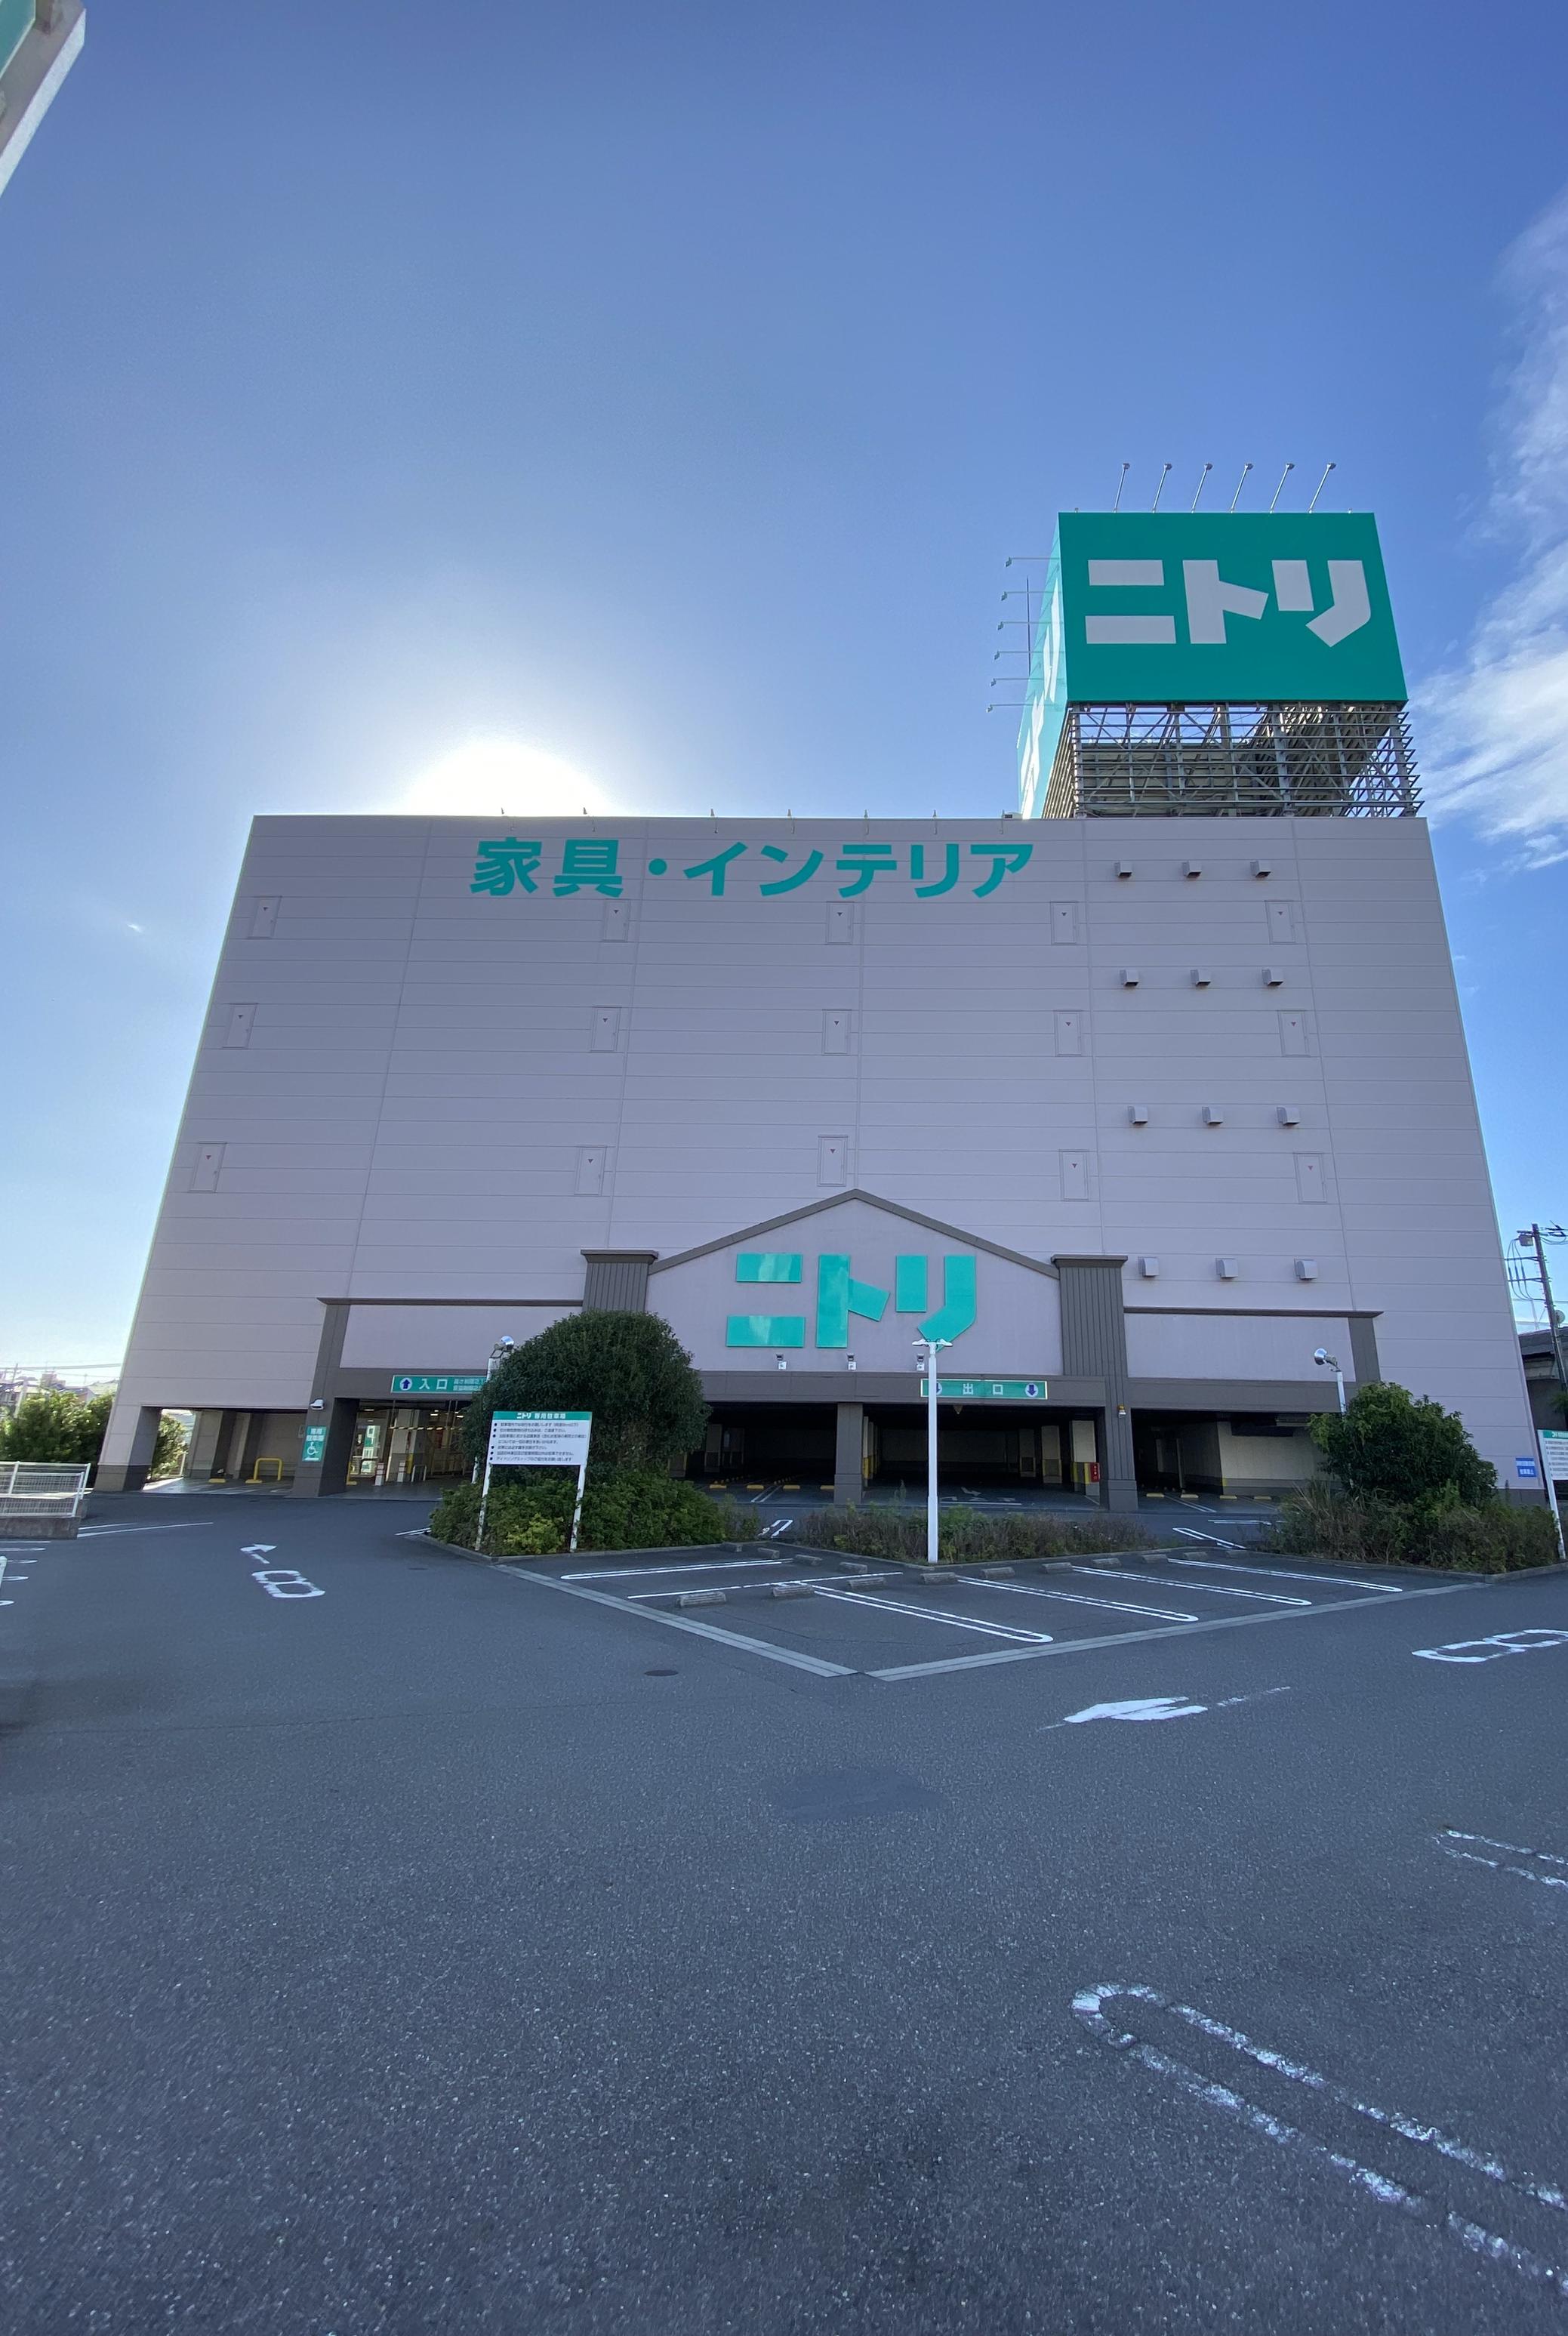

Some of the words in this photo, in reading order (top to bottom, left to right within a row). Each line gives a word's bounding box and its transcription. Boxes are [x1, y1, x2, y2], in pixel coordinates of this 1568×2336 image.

[1085, 559, 1372, 648] ニトリ
[470, 837, 1034, 898] 家具・インテリア
[726, 1253, 976, 1352] ニトリ
[418, 1378, 448, 1391] 入口
[962, 1382, 1004, 1395] 出口
